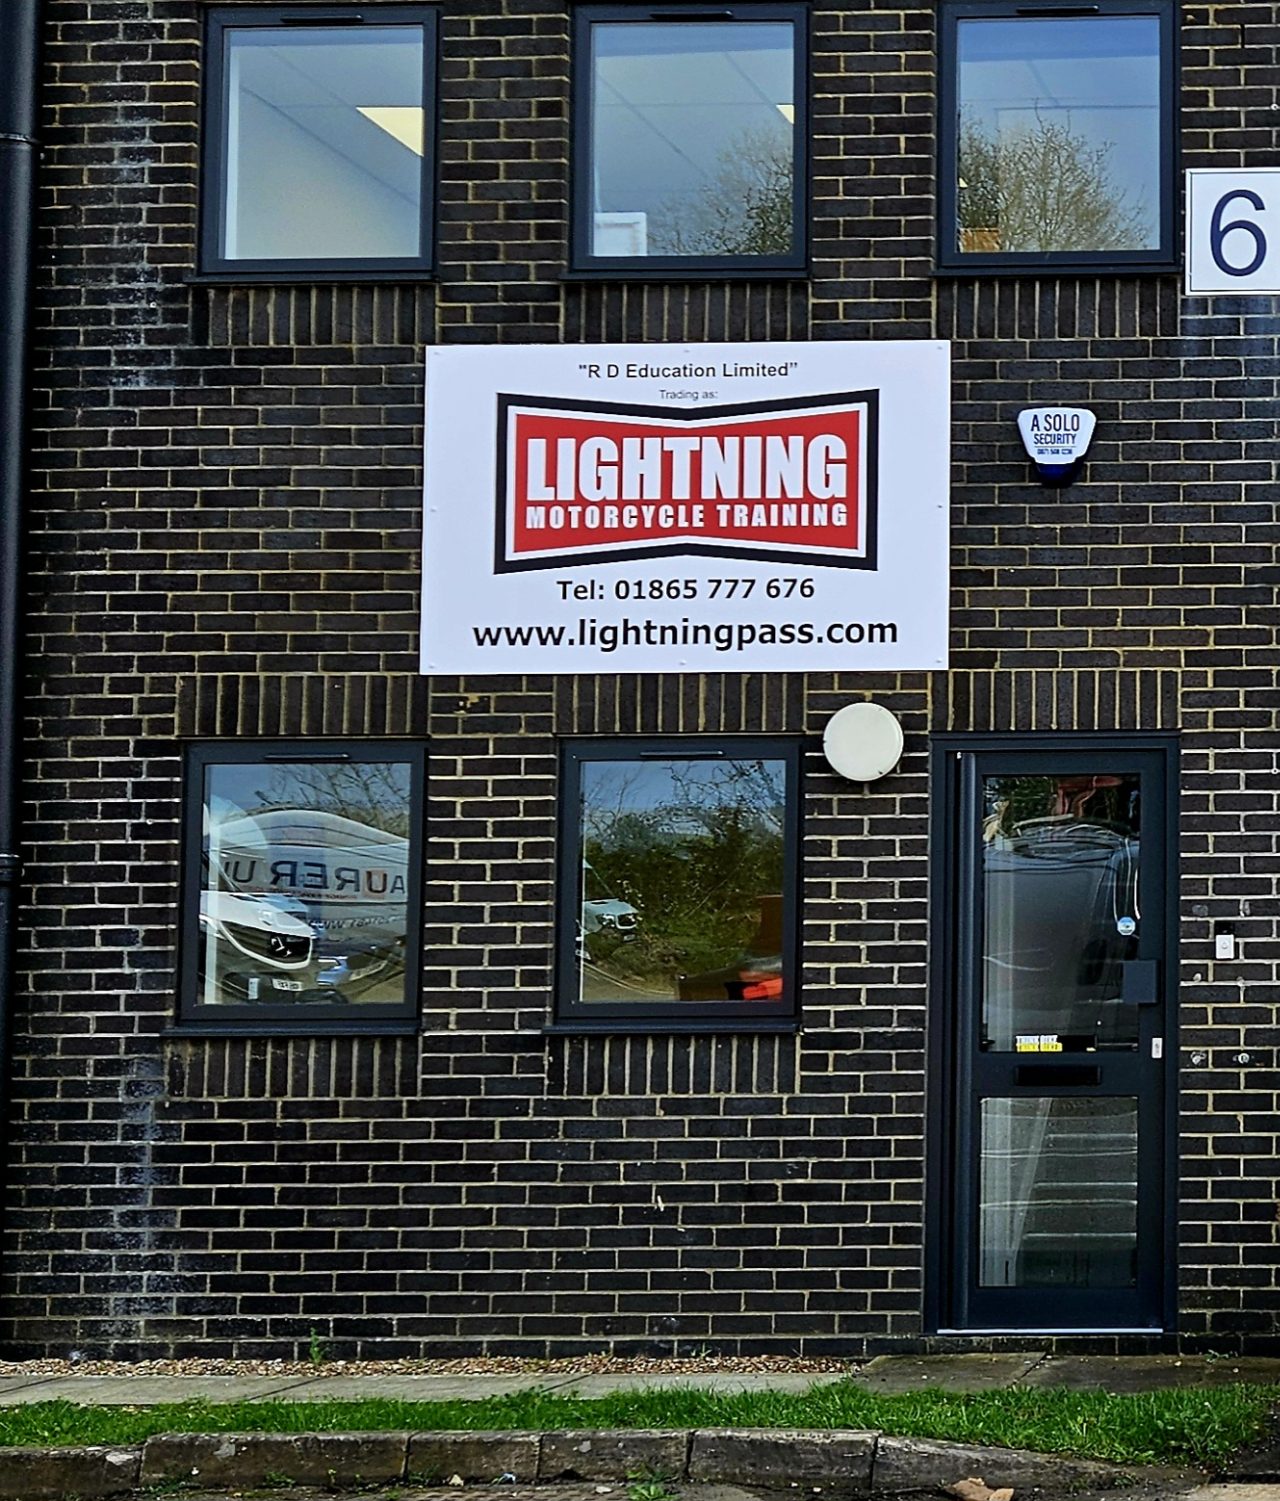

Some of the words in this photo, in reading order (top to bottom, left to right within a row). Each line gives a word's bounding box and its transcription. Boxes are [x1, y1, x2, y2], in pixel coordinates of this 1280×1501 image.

[1210, 189, 1267, 277] 6
[607, 364, 619, 378] D
[626, 363, 716, 379] Education
[659, 389, 699, 401] Trading
[701, 391, 718, 400] as:
[1031, 414, 1040, 431] A
[1044, 414, 1080, 431] SOLO
[1034, 433, 1077, 445] SECURITY
[526, 433, 848, 501] LIGHTNING
[526, 503, 704, 529] MOTORCYCLE
[717, 502, 848, 528] TRAINING
[557, 580, 604, 601] Tel:
[615, 578, 698, 600] 01865
[708, 578, 755, 599] 777
[766, 577, 815, 599] 676
[473, 617, 898, 652] www.lightningpass.com
